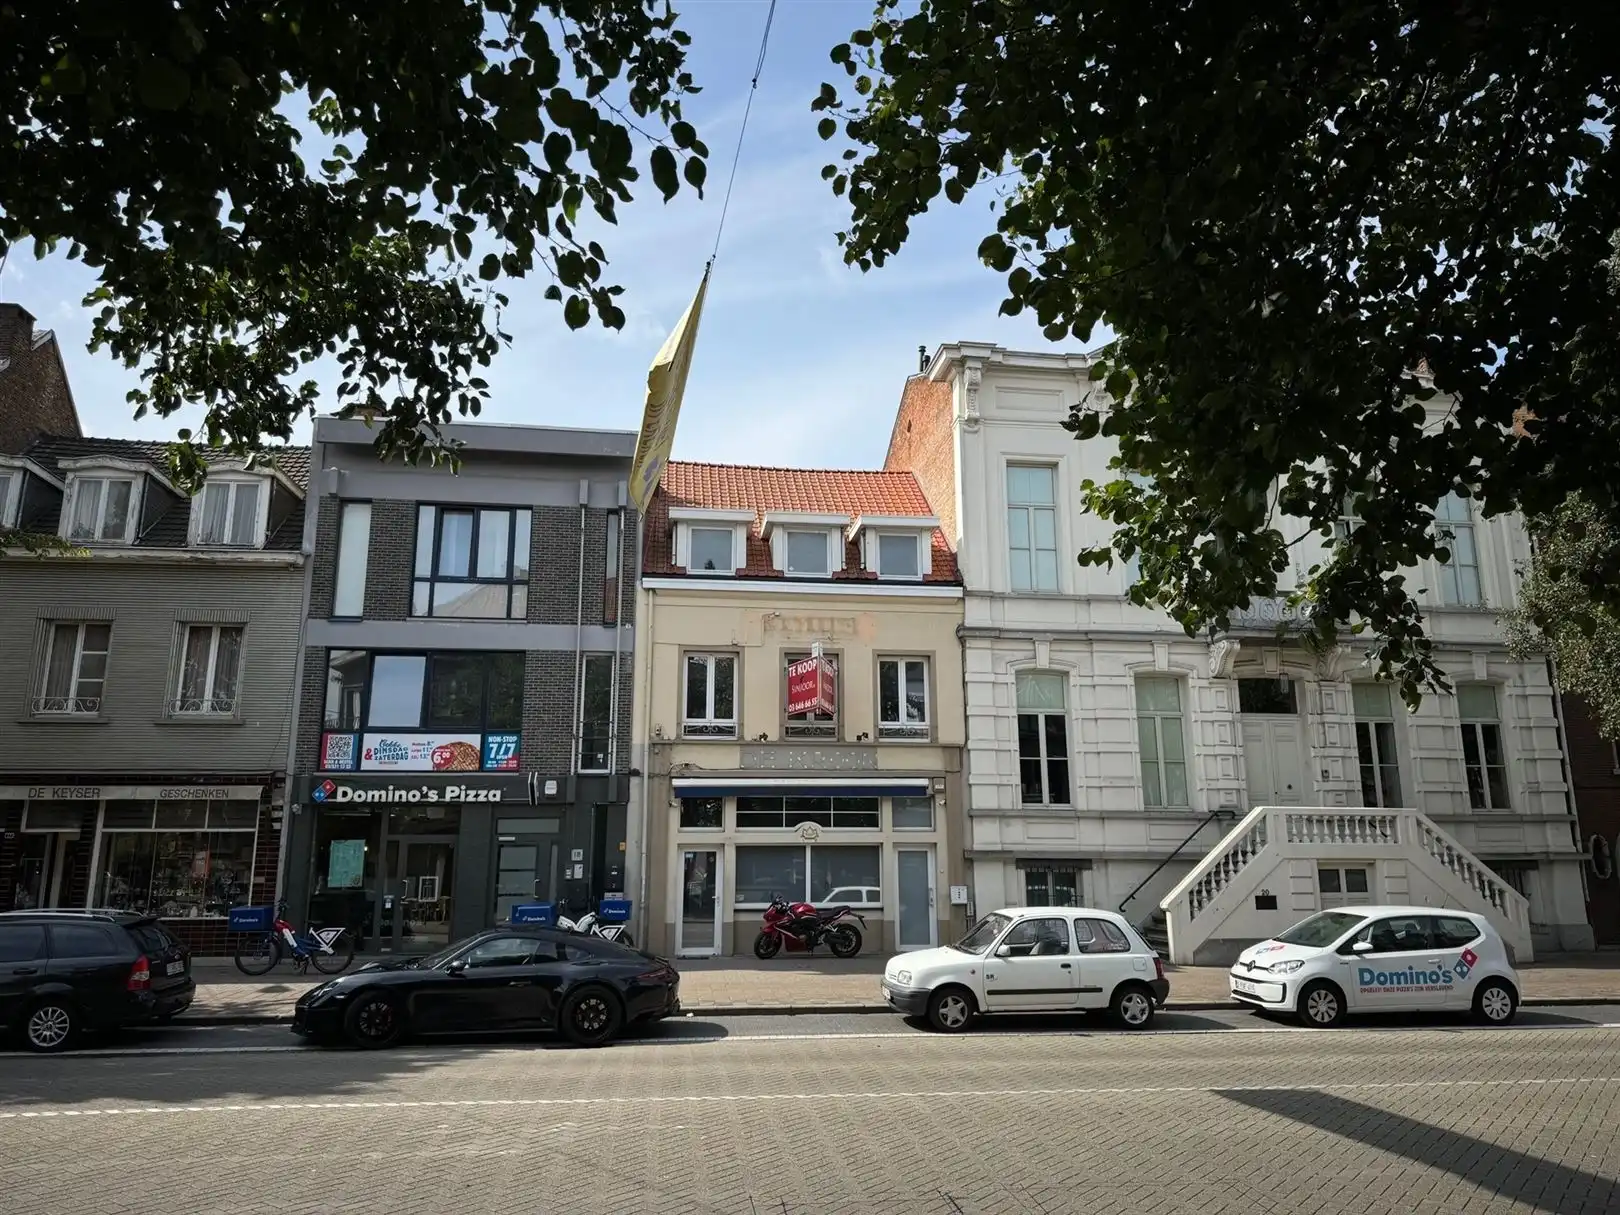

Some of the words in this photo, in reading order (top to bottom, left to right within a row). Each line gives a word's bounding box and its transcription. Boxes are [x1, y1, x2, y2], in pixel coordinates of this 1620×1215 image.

[789, 665, 796, 677] TE
[797, 659, 817, 675] KOOP
[364, 748, 373, 761] &
[373, 747, 409, 756] DINSDAG
[373, 752, 409, 761] ZATERDAG
[489, 743, 516, 759] 7/7
[28, 787, 46, 799] DE
[52, 787, 100, 799] KEYSER
[160, 787, 229, 799] GESCHENKEN
[336, 786, 439, 802] Domino's
[445, 786, 501, 802] Pizza
[1358, 965, 1454, 986] Domino's
